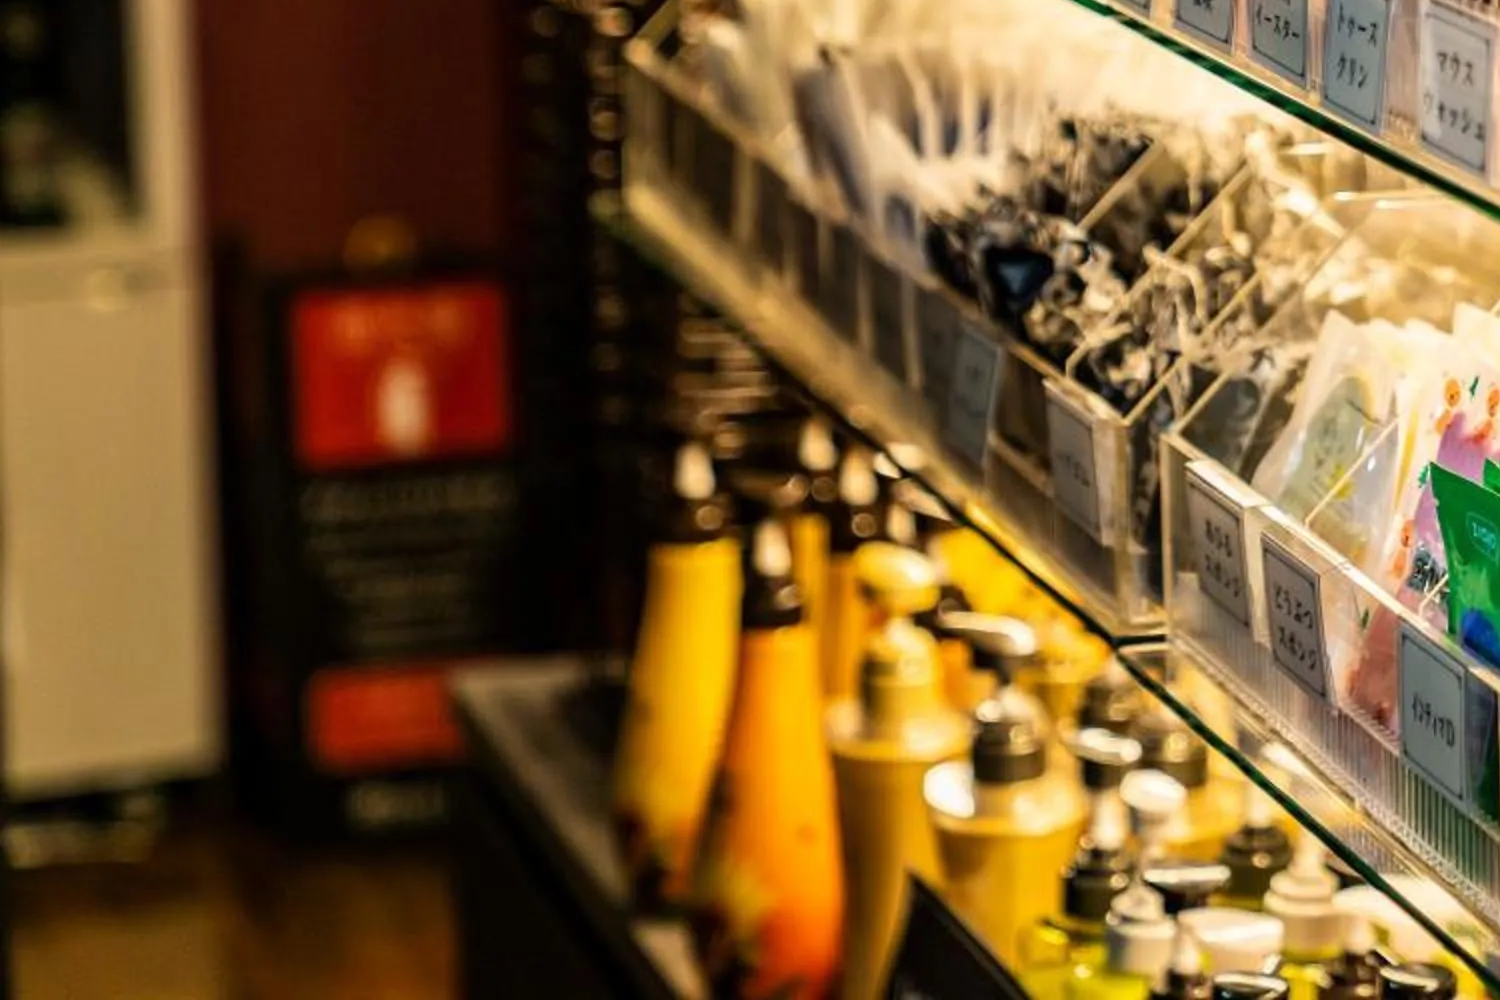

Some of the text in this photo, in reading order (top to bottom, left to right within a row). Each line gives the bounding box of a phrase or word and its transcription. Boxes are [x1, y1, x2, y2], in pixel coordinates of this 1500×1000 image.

[1256, 3, 1300, 41] イースター
[1337, 3, 1377, 47] トゥース
[1336, 53, 1368, 88] クリン
[1437, 51, 1473, 87] マウス
